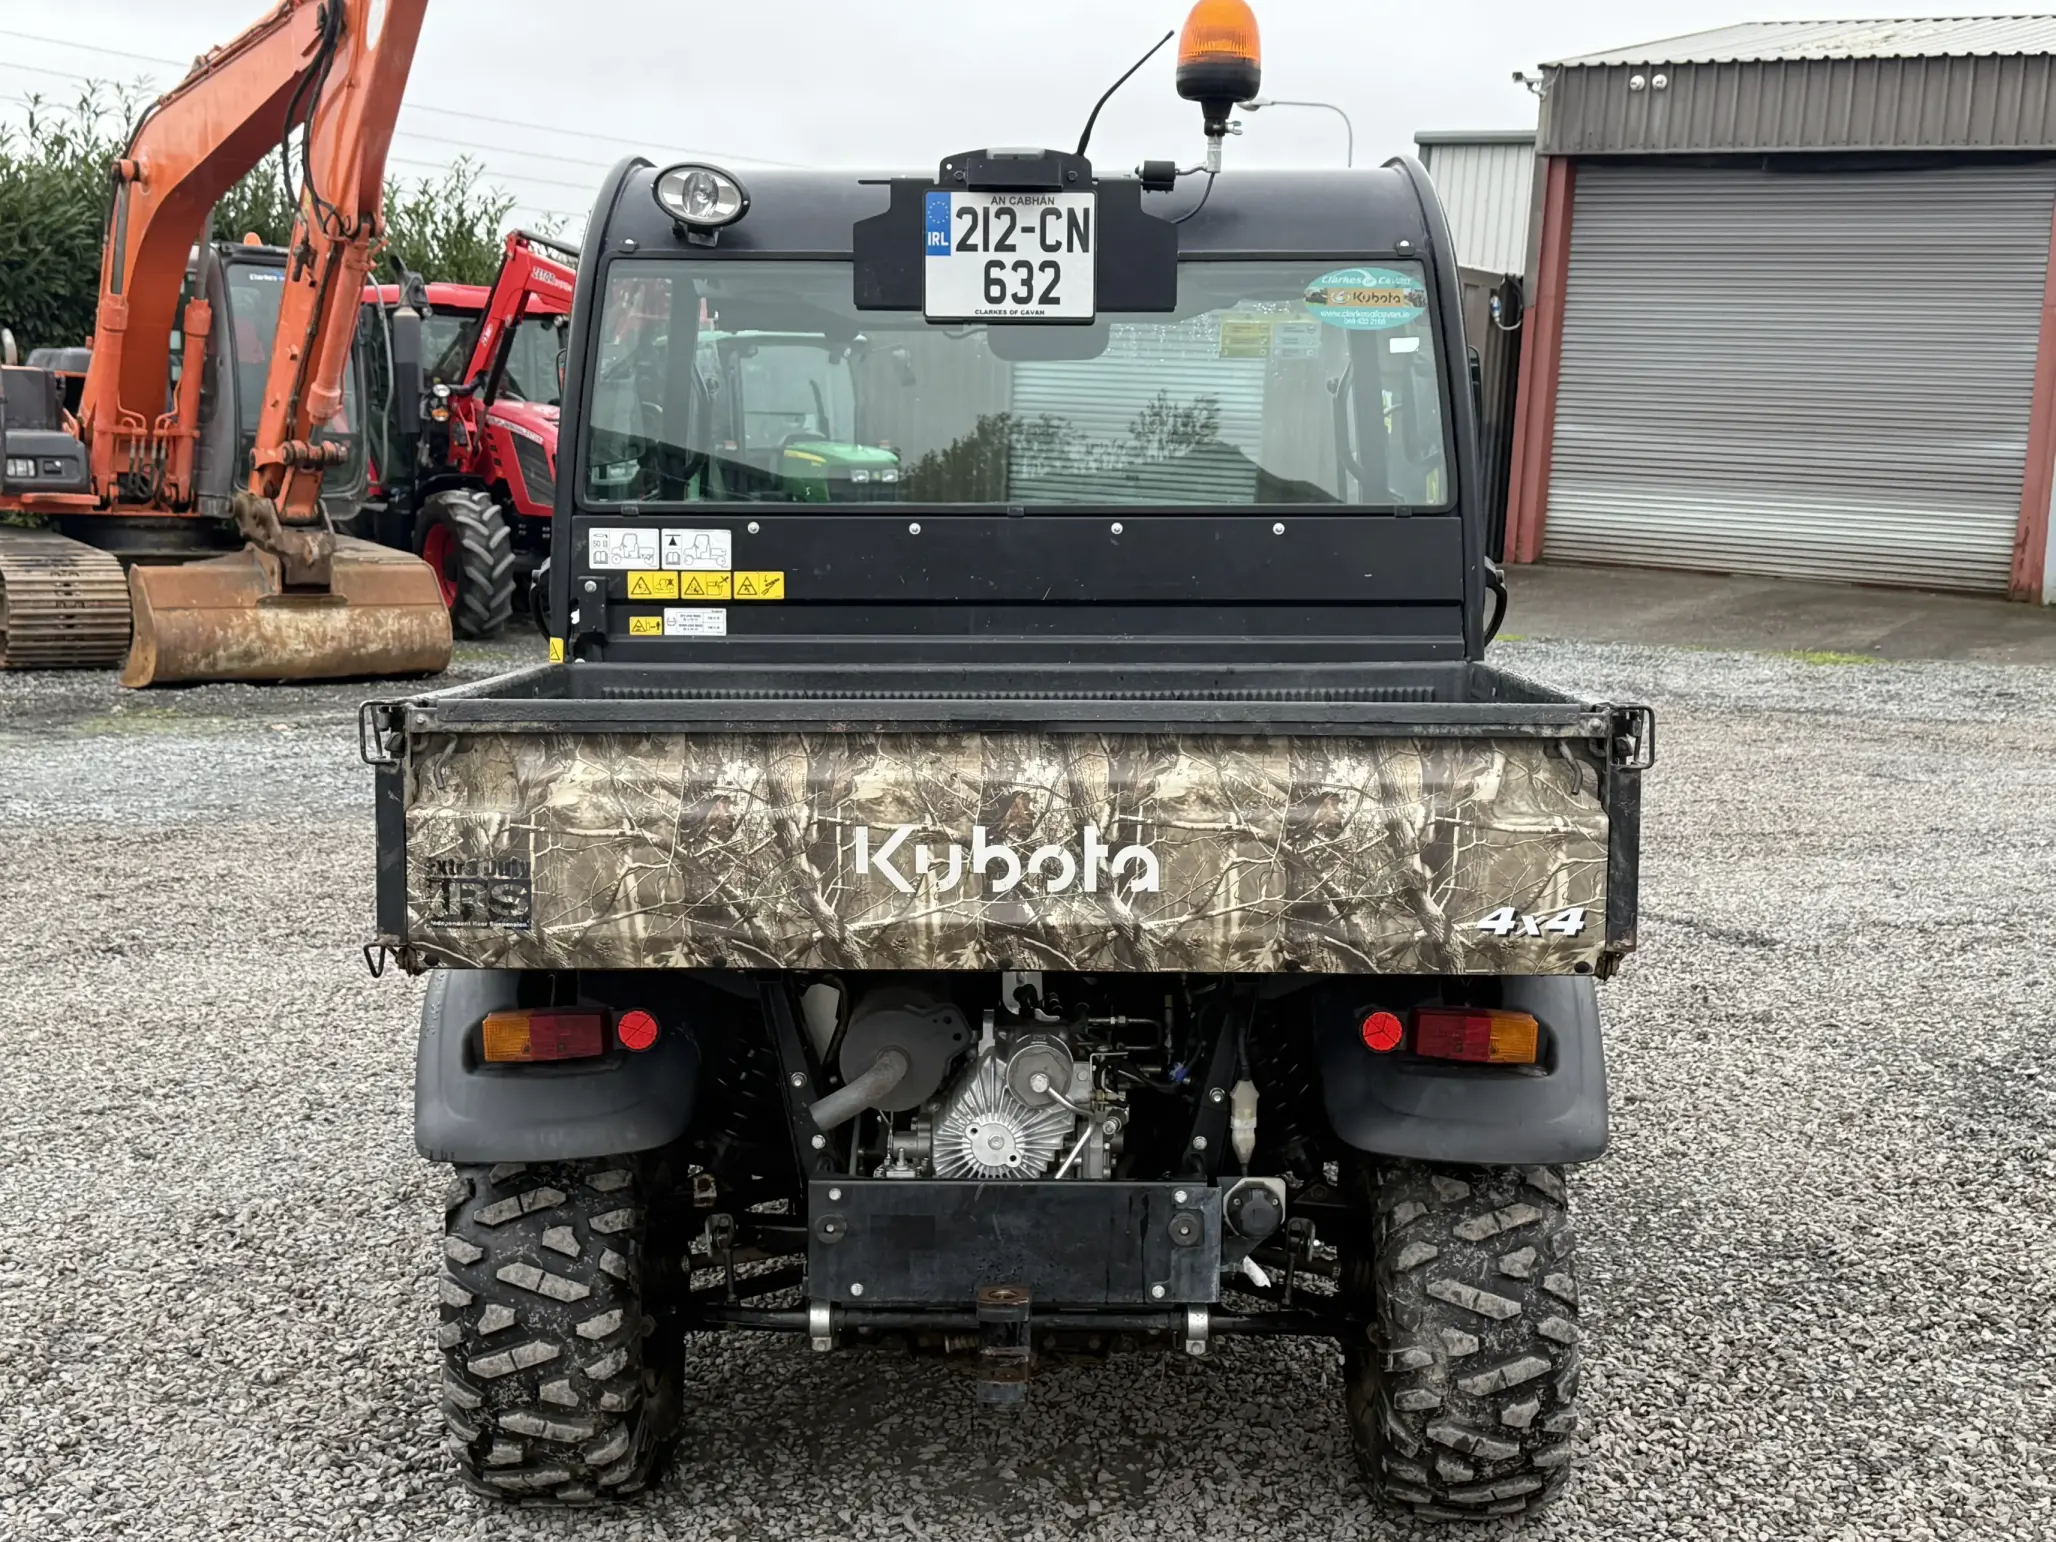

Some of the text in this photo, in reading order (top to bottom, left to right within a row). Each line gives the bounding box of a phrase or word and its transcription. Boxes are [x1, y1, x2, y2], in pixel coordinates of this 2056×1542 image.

[990, 193, 1055, 206] AN CABHÁN
[927, 231, 949, 247] IRL
[955, 206, 1090, 253] 212-CN
[983, 259, 1061, 305] 632
[1321, 275, 1361, 285] Clarkes
[1353, 291, 1401, 304] Kubota
[855, 825, 1160, 893] Kubota
[429, 882, 530, 917] IRS
[1476, 906, 1588, 938] 4x4
